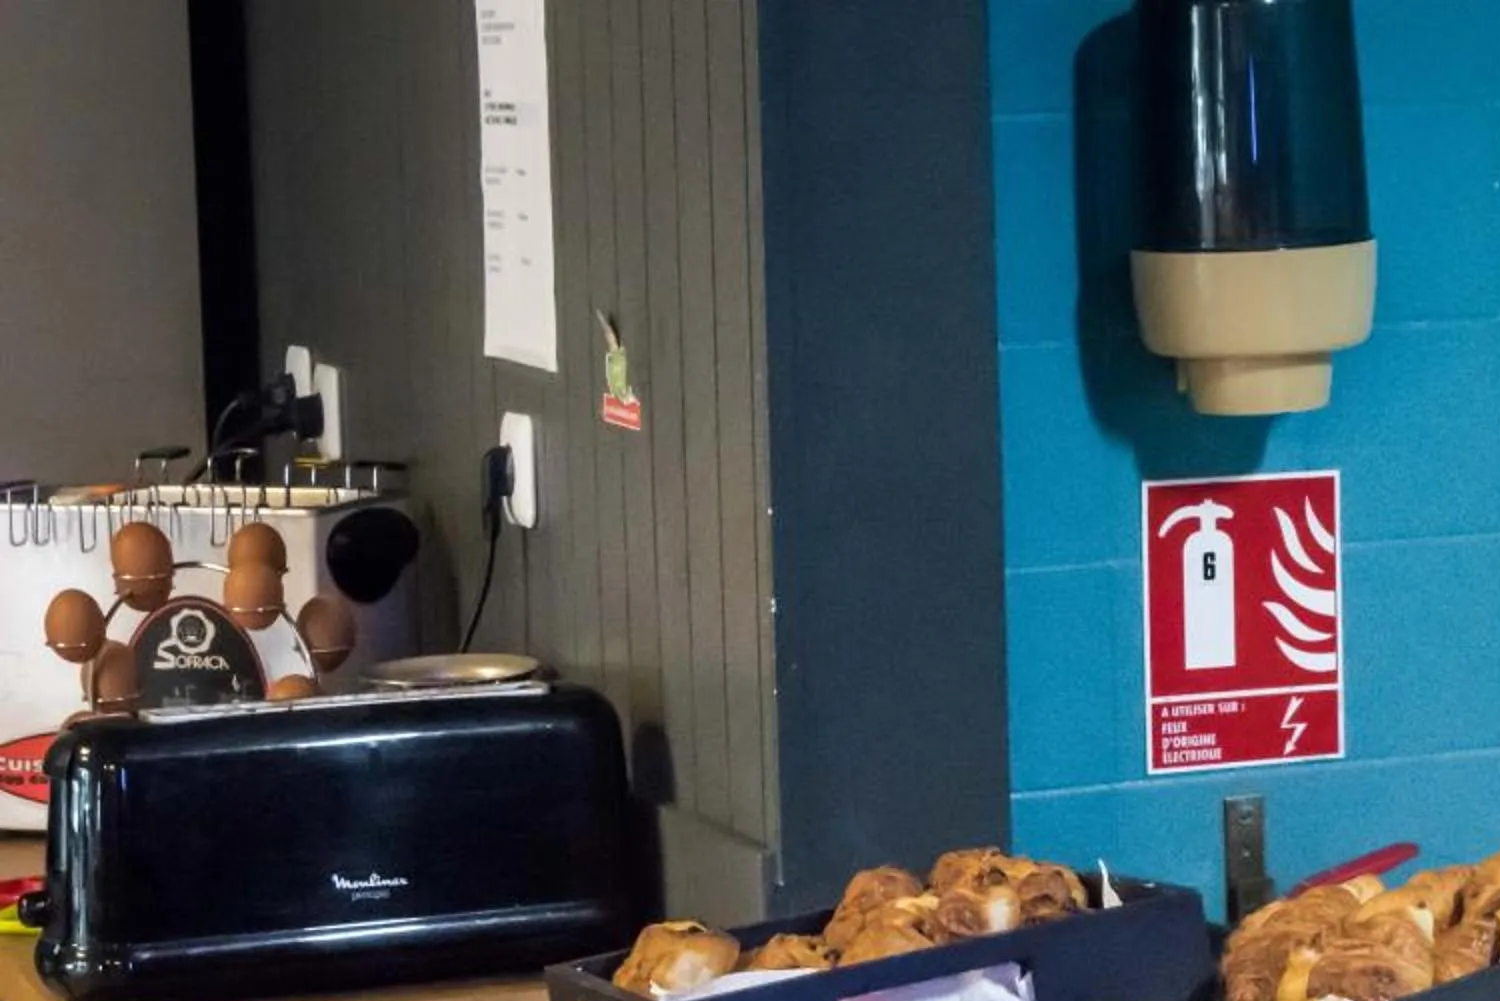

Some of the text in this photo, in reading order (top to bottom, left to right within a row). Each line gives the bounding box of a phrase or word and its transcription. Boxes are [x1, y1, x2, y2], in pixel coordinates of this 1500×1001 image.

[1203, 552, 1216, 580] 6
[1161, 706, 1169, 717] A
[1171, 703, 1216, 717] UTILISER
[1162, 733, 1216, 749] D'ORIGINE
